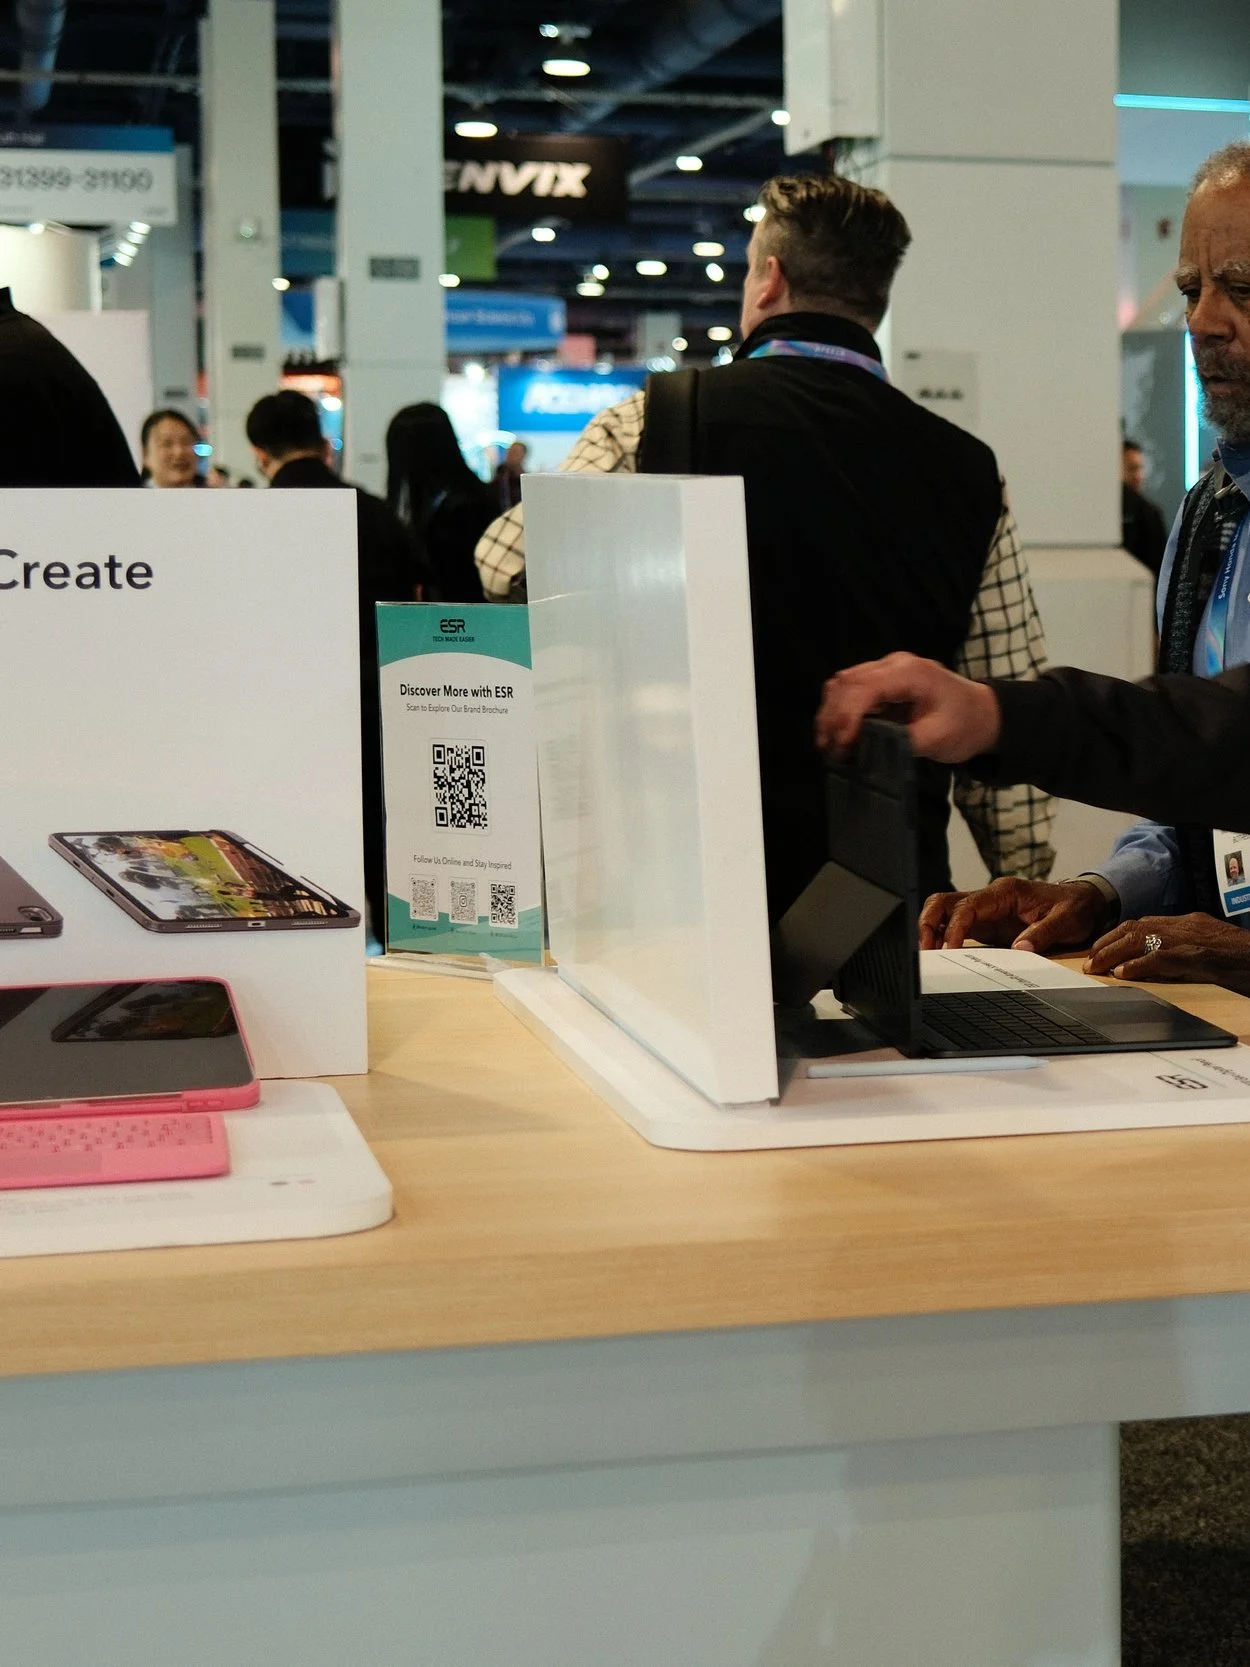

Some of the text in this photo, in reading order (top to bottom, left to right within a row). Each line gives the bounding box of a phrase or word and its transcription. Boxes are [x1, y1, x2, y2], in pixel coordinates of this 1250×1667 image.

[0, 549, 153, 590] Create
[1218, 576, 1230, 600] Sony
[440, 619, 466, 633] ESR
[400, 683, 514, 699] Discover More with ESR
[406, 703, 508, 715] Scan to Explore Our Brand Brochure
[413, 854, 512, 871] Follow Us Online and Stay Inspired
